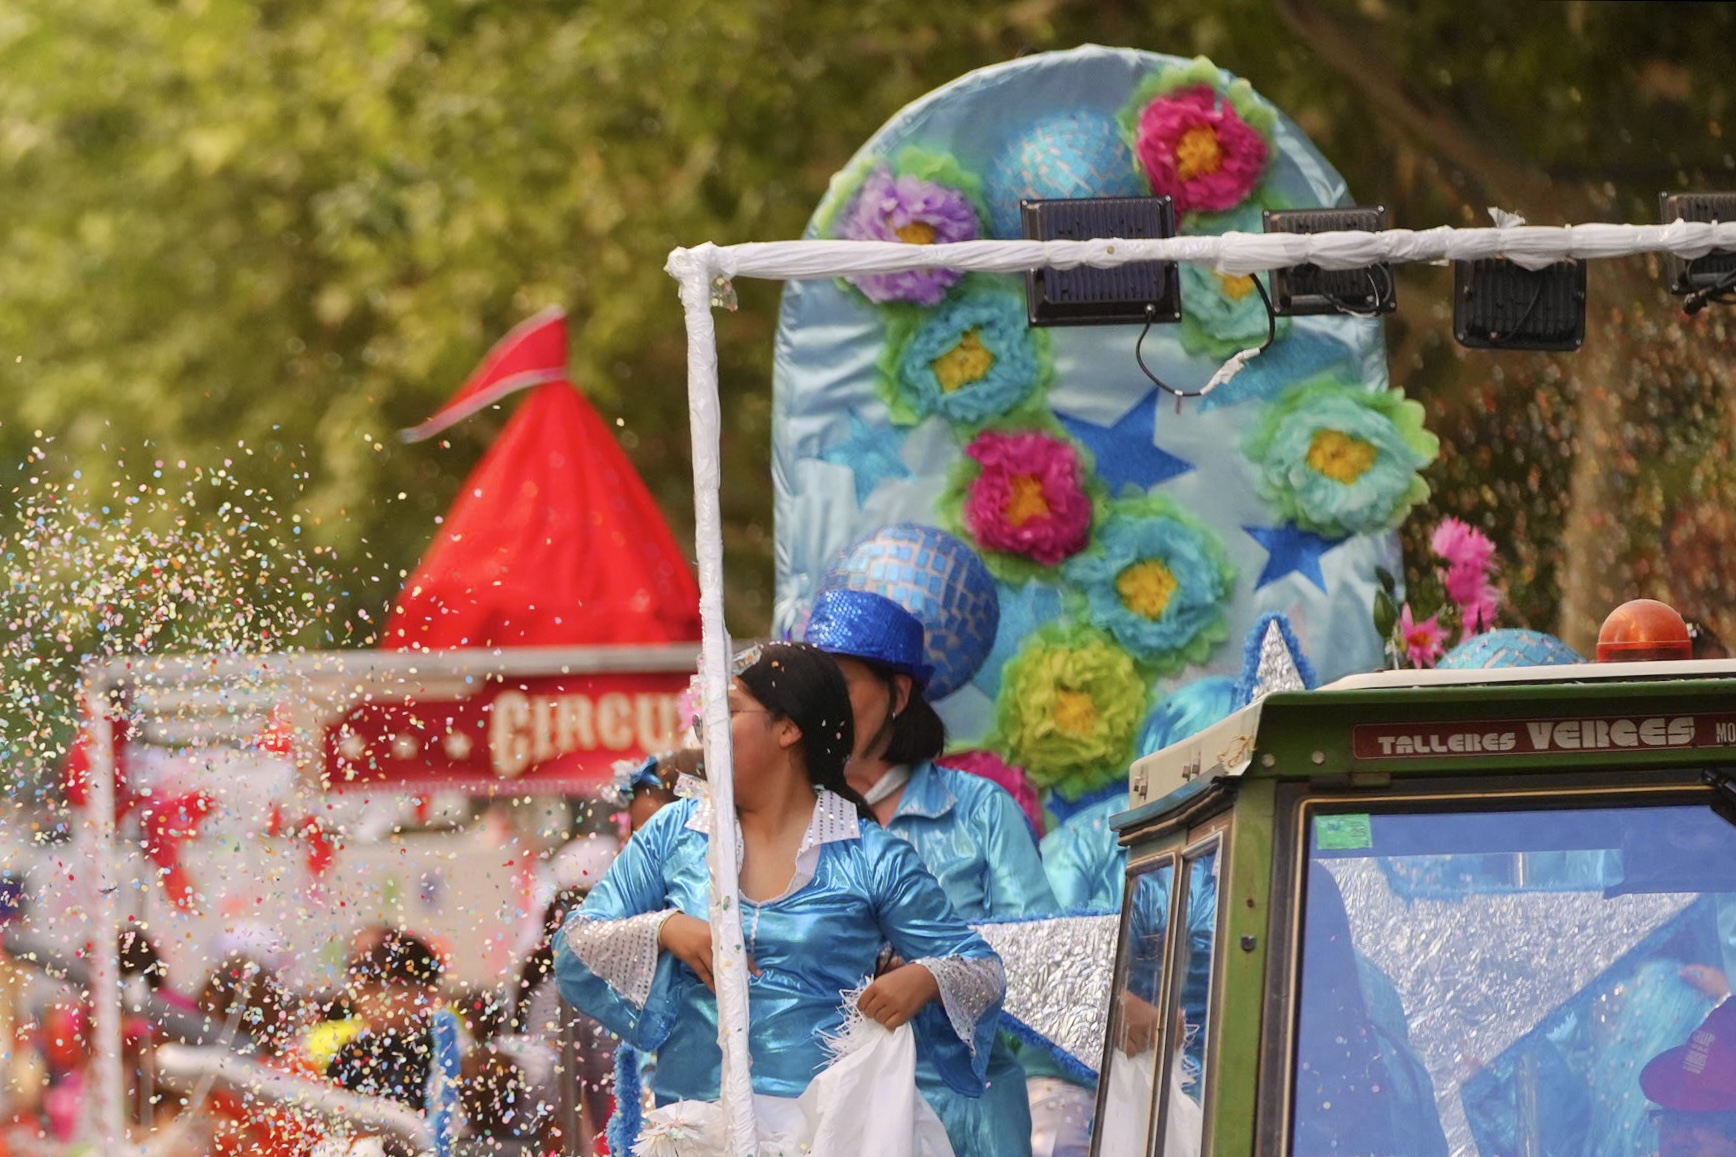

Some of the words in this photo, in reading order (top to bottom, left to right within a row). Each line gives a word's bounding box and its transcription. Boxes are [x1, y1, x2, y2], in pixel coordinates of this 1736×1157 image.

[488, 690, 679, 780] CIRCU
[1377, 732, 1517, 755] TALLERES
[1526, 716, 1696, 750] VERGES
